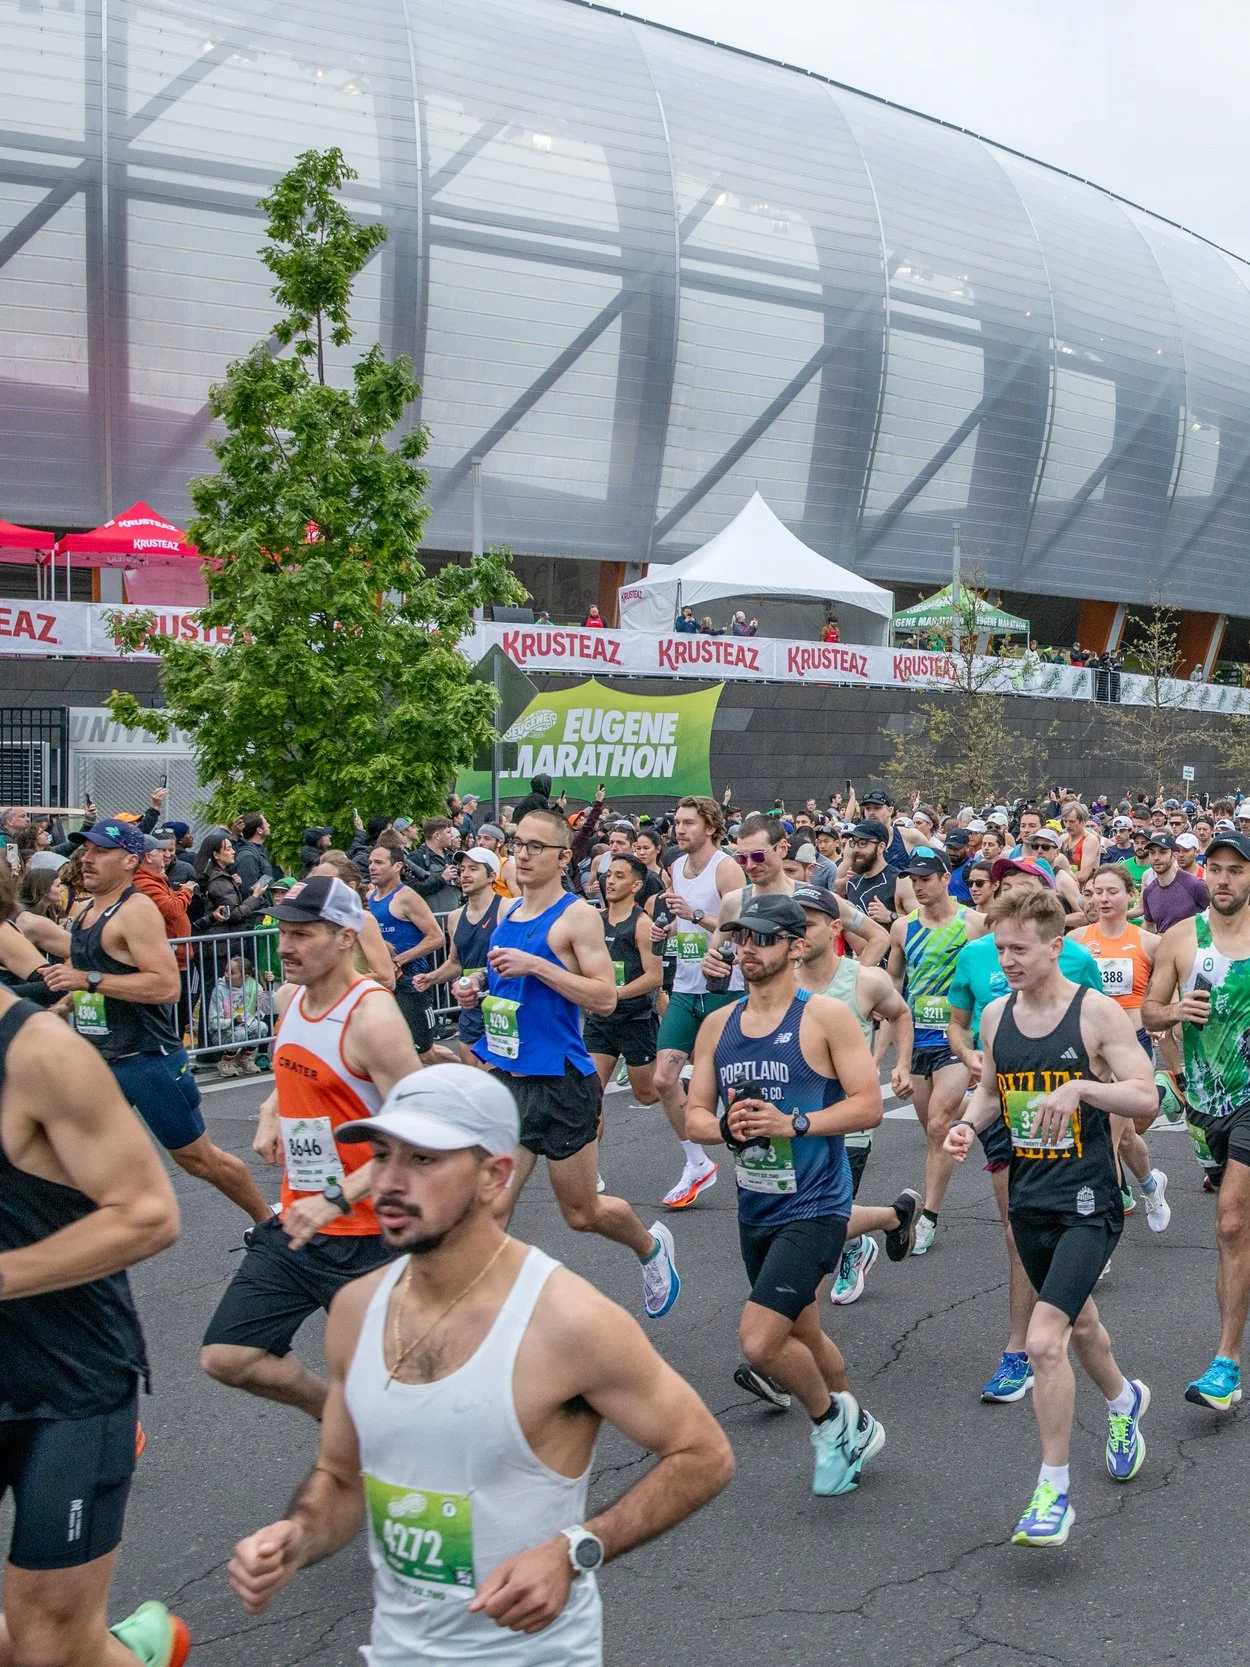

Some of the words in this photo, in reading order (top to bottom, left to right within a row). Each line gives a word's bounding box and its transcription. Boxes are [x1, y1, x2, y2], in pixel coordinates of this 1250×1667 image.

[118, 518, 178, 531] KRUSTEAZ
[133, 538, 180, 551] KRUSTEAZ
[621, 589, 643, 603] KRUSTEAZ
[892, 617, 916, 627] GENE
[503, 631, 623, 665] KRUSTEAZ
[658, 638, 760, 671] KRUSTEAZ
[787, 646, 868, 678] KRUSTEAZ
[893, 654, 958, 682] KRUSTEAZ
[563, 708, 679, 744] EUGENE
[499, 743, 678, 778] MARATHON
[682, 943, 699, 954] 3521
[1100, 970, 1123, 983] 388
[923, 1006, 944, 1019] 3211
[279, 1056, 318, 1081] CRATER
[720, 1060, 790, 1087] PORTLAND
[770, 1086, 785, 1099] CO.
[289, 1138, 322, 1157] 8646
[383, 1518, 444, 1567] 4272
